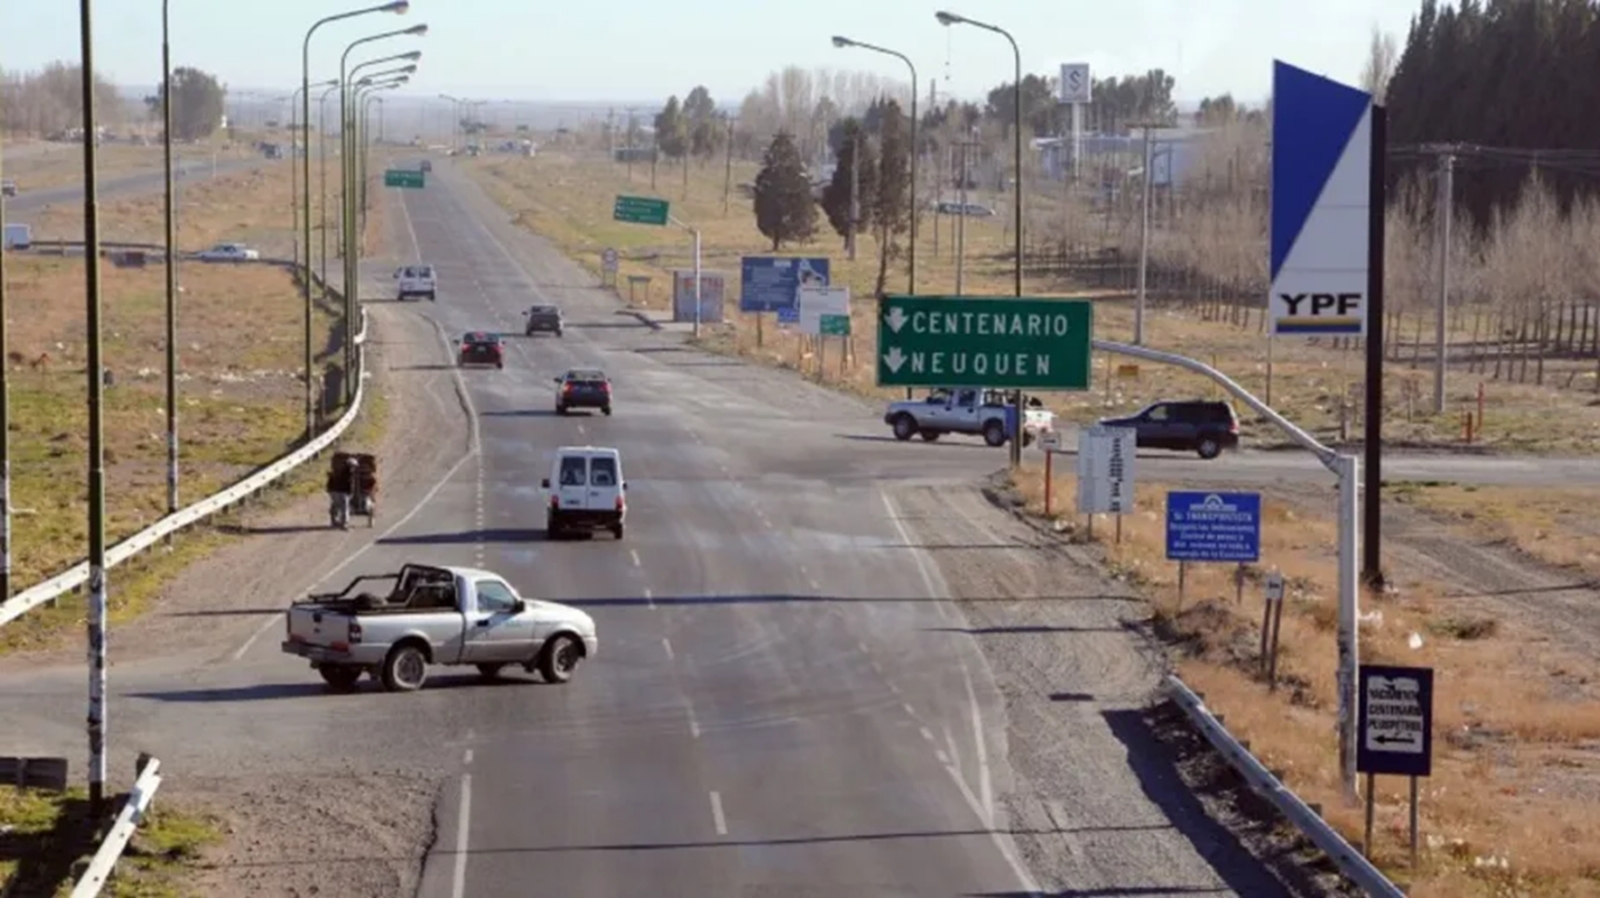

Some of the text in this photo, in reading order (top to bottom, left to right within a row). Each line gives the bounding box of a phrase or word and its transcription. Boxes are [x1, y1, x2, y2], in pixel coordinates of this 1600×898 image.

[1279, 293, 1362, 315] YPF
[912, 312, 1068, 336] CENTENARIO
[911, 352, 1050, 375] NEUQUEN
